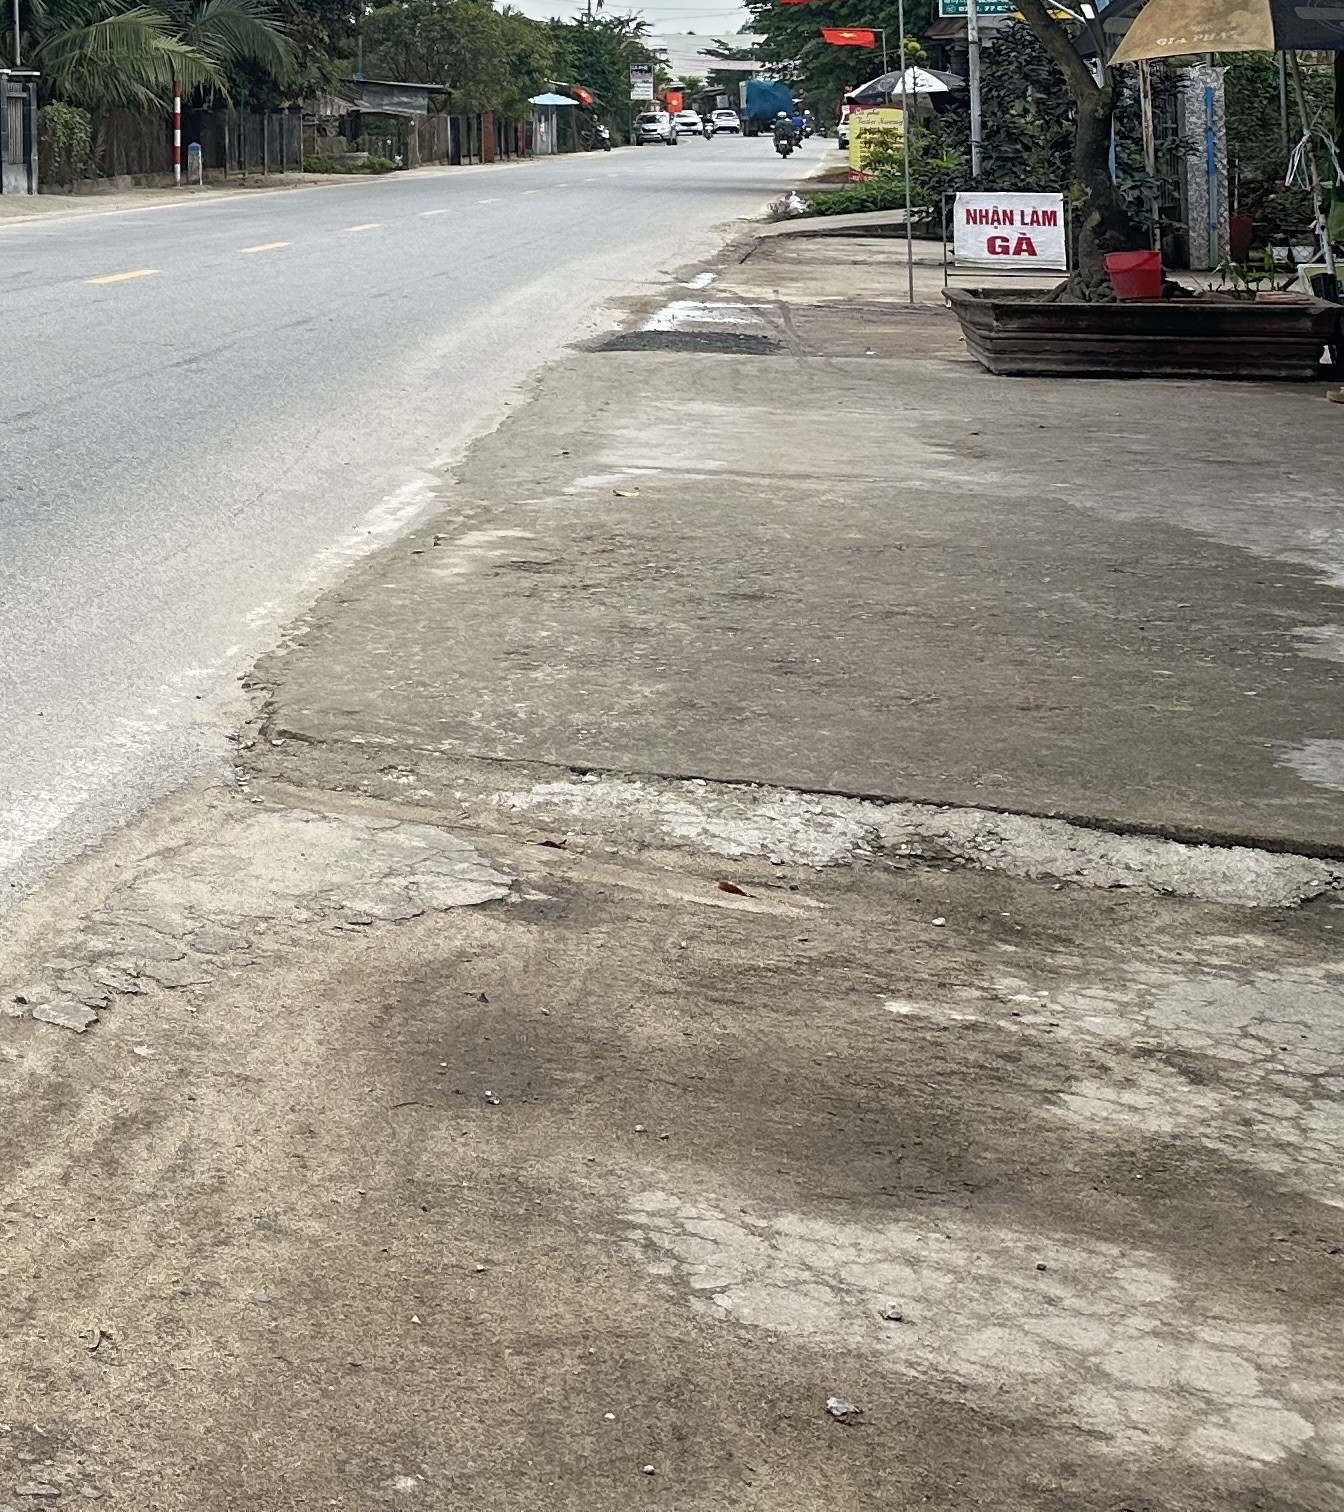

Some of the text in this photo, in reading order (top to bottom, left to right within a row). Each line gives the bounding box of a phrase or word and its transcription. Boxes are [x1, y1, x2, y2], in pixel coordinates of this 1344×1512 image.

[965, 205, 1057, 229] NHẬN LÀM
[986, 231, 1038, 256] GÀ
